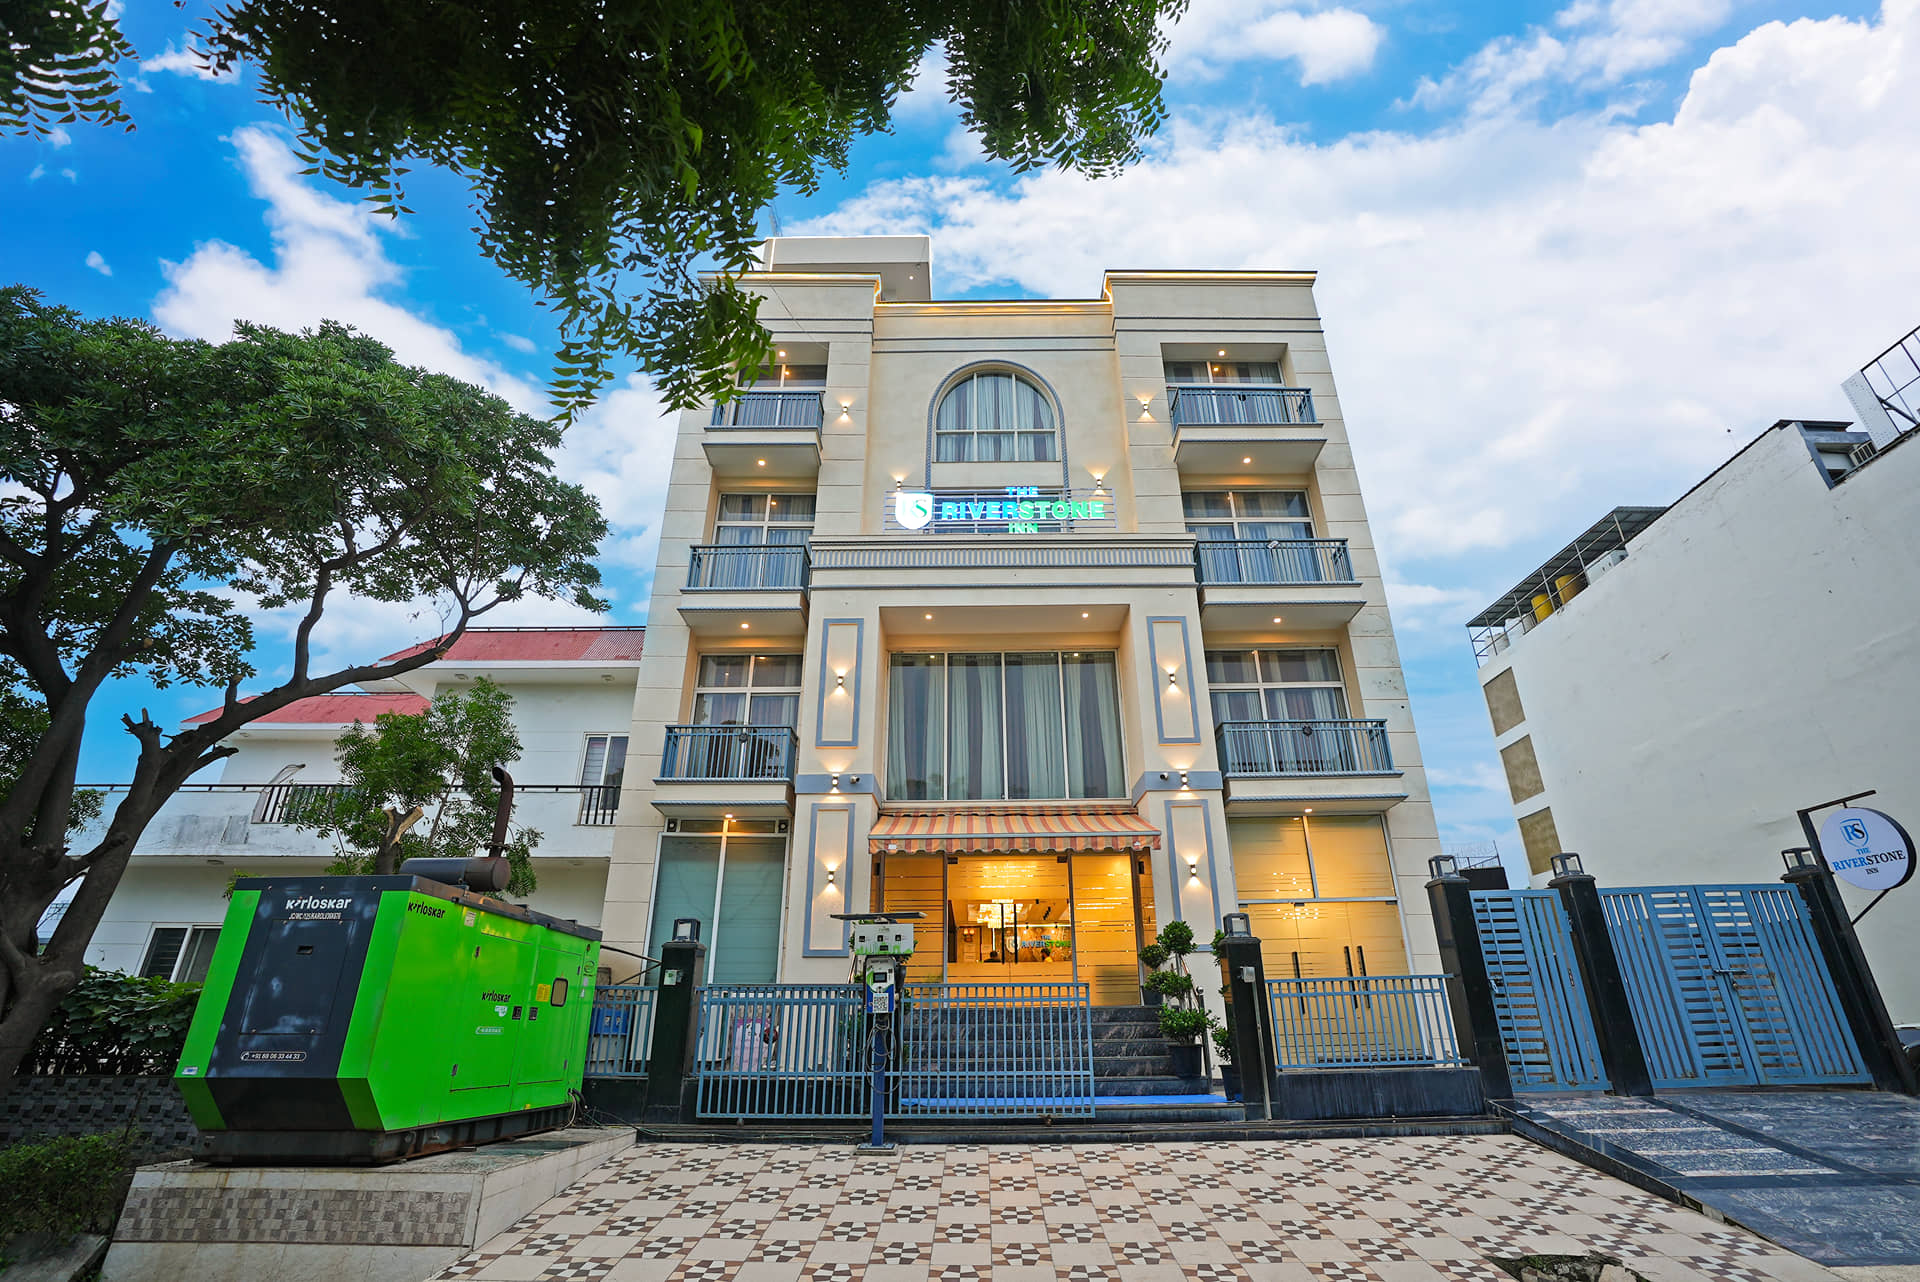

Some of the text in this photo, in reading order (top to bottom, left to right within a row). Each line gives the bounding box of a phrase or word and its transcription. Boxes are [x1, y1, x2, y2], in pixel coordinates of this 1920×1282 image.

[1005, 486, 1039, 497] THE
[941, 501, 1106, 520] RIVERSTONE
[1008, 522, 1039, 534] INN
[1856, 847, 1872, 855] THE
[1832, 850, 1906, 871] RIVERSTONE
[1866, 867, 1879, 875] INN
